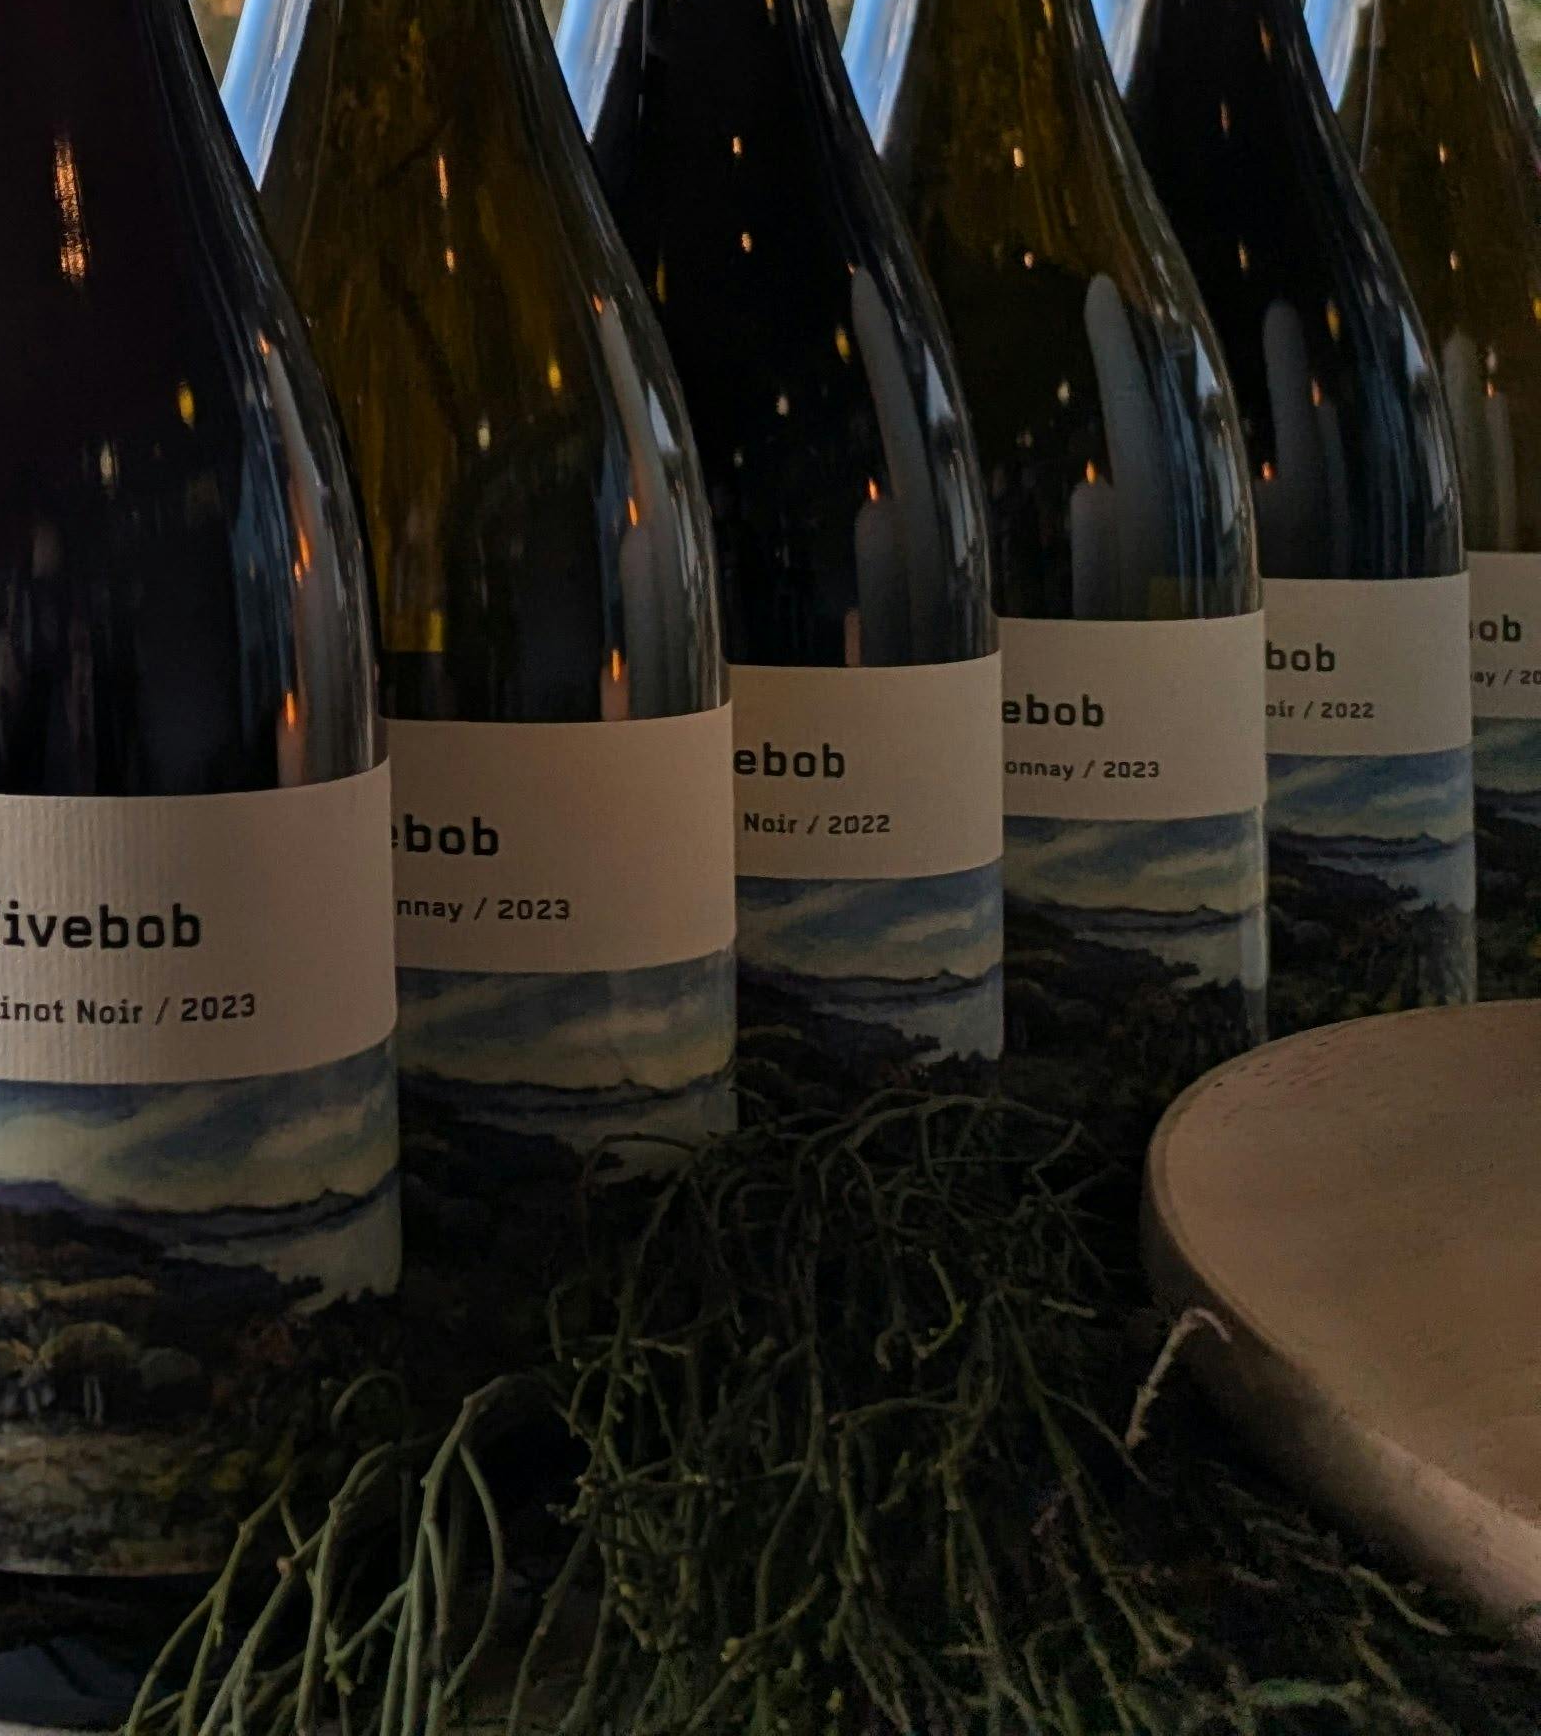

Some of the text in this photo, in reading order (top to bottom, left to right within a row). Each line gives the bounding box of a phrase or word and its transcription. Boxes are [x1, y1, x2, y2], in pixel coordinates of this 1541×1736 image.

[1469, 614, 1521, 642] ob
[1002, 694, 1104, 726] ebob
[1320, 702, 1375, 719] 2022
[733, 742, 845, 778] ebob
[1004, 760, 1160, 781] onnay / 2023
[391, 814, 499, 856] bob
[743, 813, 891, 835] Noir / 2022
[473, 897, 487, 921] /
[497, 898, 570, 920] 2023
[76, 1000, 143, 1026] Noir
[154, 997, 170, 1026] /
[180, 993, 257, 1022] 2023
